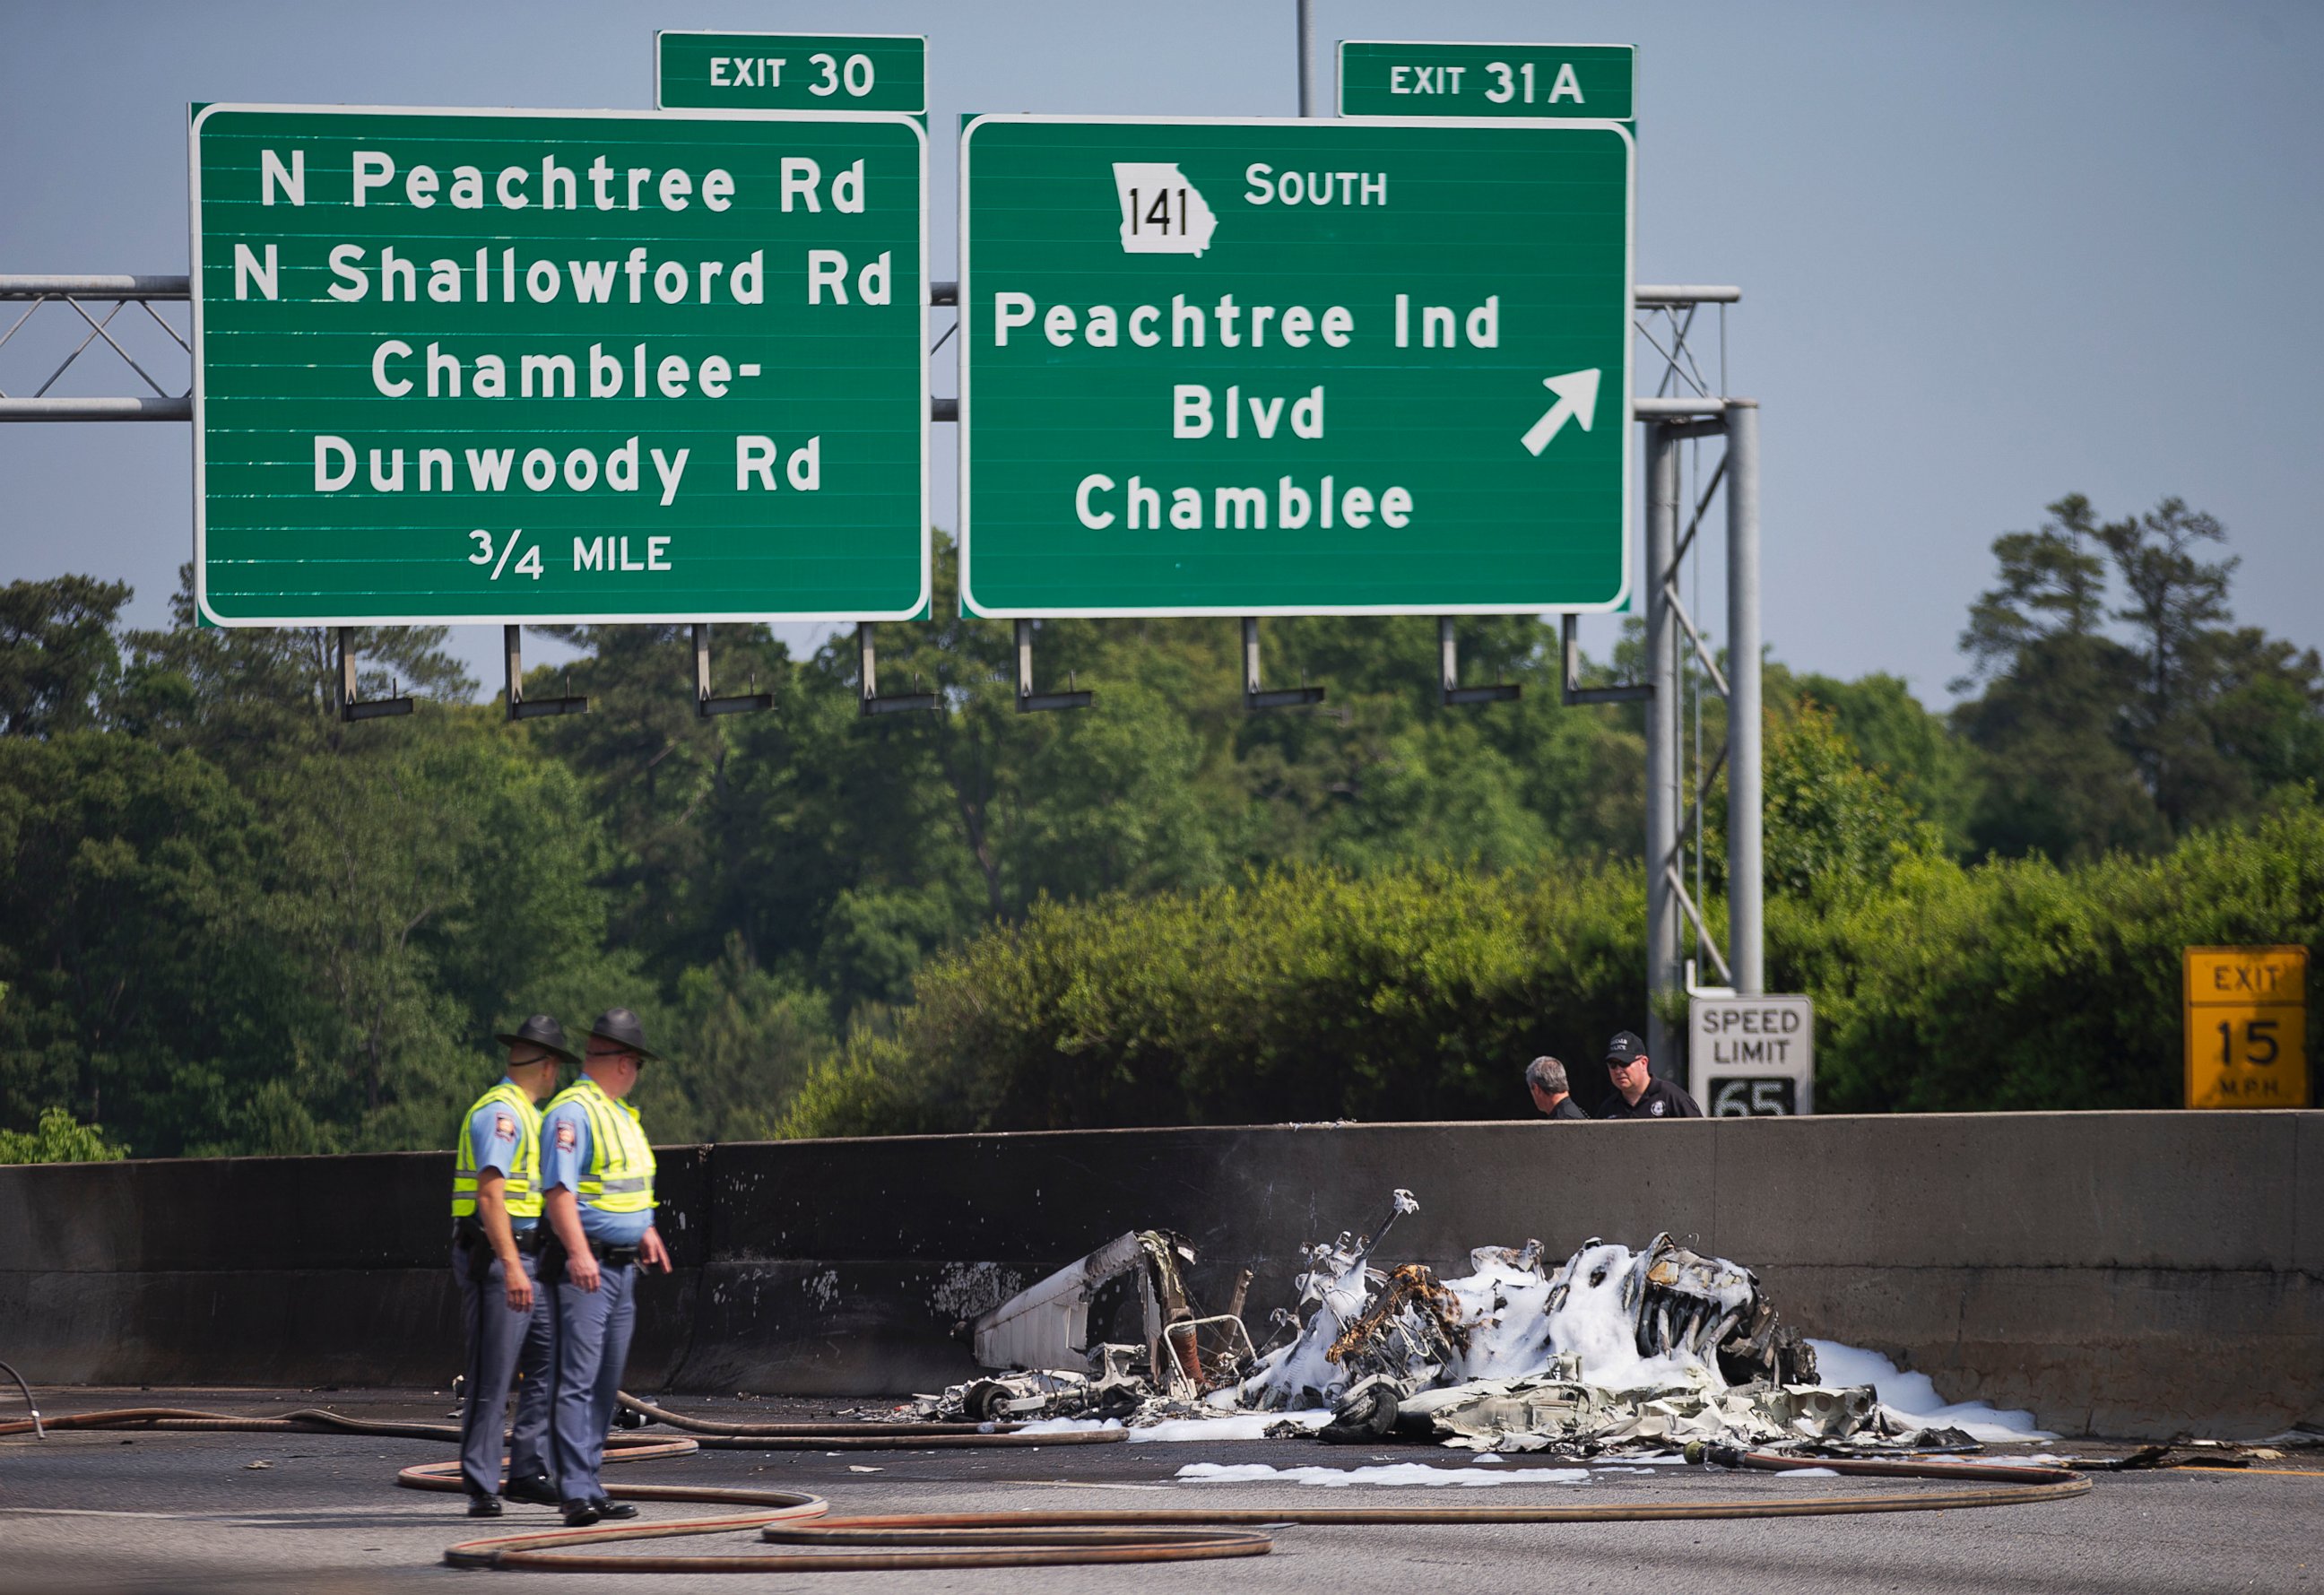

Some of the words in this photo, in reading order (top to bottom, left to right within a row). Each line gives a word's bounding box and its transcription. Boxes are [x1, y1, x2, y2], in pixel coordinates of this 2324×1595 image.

[710, 56, 786, 87] EXIT
[808, 53, 875, 97] 30
[1390, 65, 1465, 95] EXIT
[261, 149, 306, 206] N
[352, 151, 735, 212] Peachtree
[780, 157, 866, 214] Rd
[1244, 162, 1387, 206] SOUTH
[1130, 187, 1188, 237] 141
[234, 243, 279, 301] N
[326, 243, 765, 305] Shallowford
[808, 249, 892, 306] Rd
[994, 291, 1354, 348] Peachtree
[1395, 293, 1499, 349] Ind
[371, 340, 762, 399] Chamblee-
[1173, 384, 1324, 439] Blvd
[314, 435, 690, 507] Dunwoody
[736, 435, 821, 492] Rd
[1075, 473, 1414, 530] Chamblee
[573, 536, 672, 571] MILE
[2215, 966, 2278, 991] EXIT
[1703, 1010, 1799, 1033] SPEED
[2218, 1020, 2278, 1066] 15
[1714, 1040, 1791, 1063] LIMIT
[1713, 1080, 1785, 1117] 65
